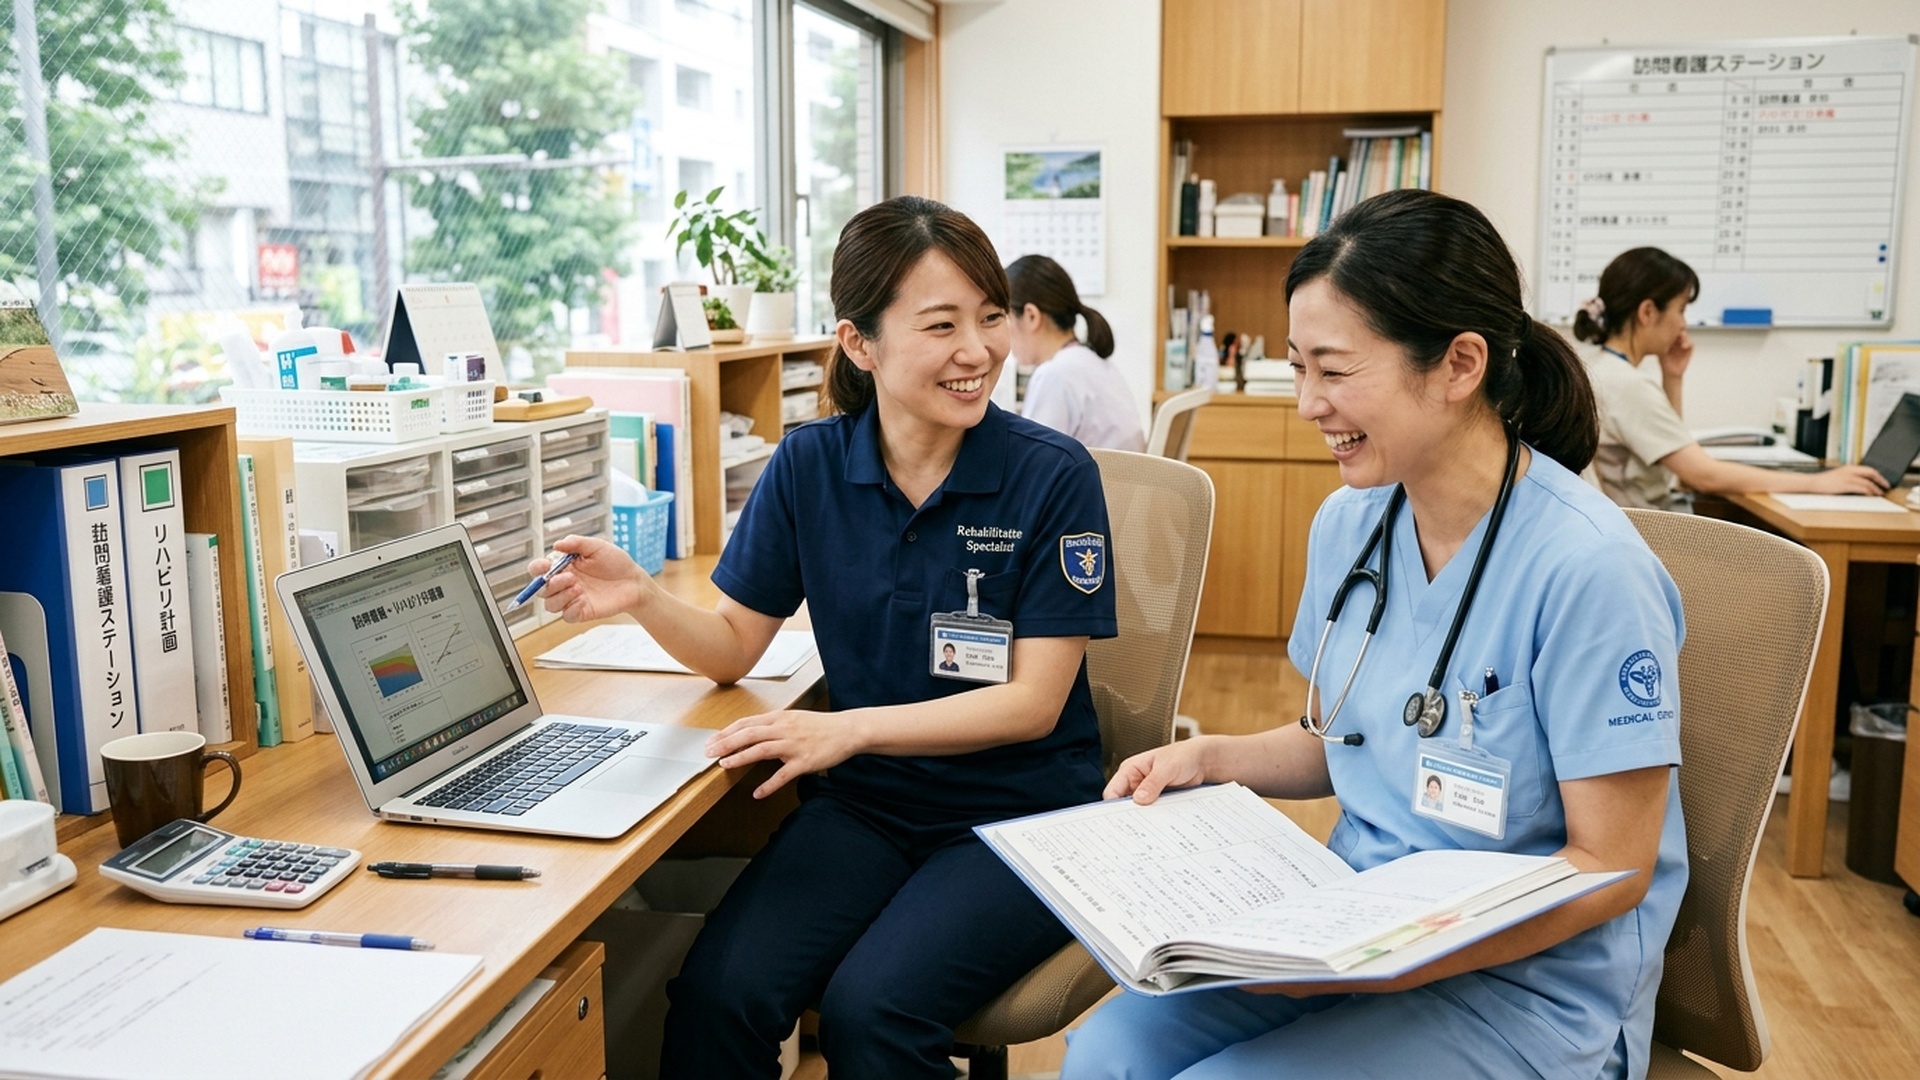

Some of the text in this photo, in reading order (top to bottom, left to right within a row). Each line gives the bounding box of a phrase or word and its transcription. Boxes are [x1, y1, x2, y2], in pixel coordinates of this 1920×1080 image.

[155, 523, 178, 654] リハビリ計画
[1608, 712, 1655, 727] MEDICAL
